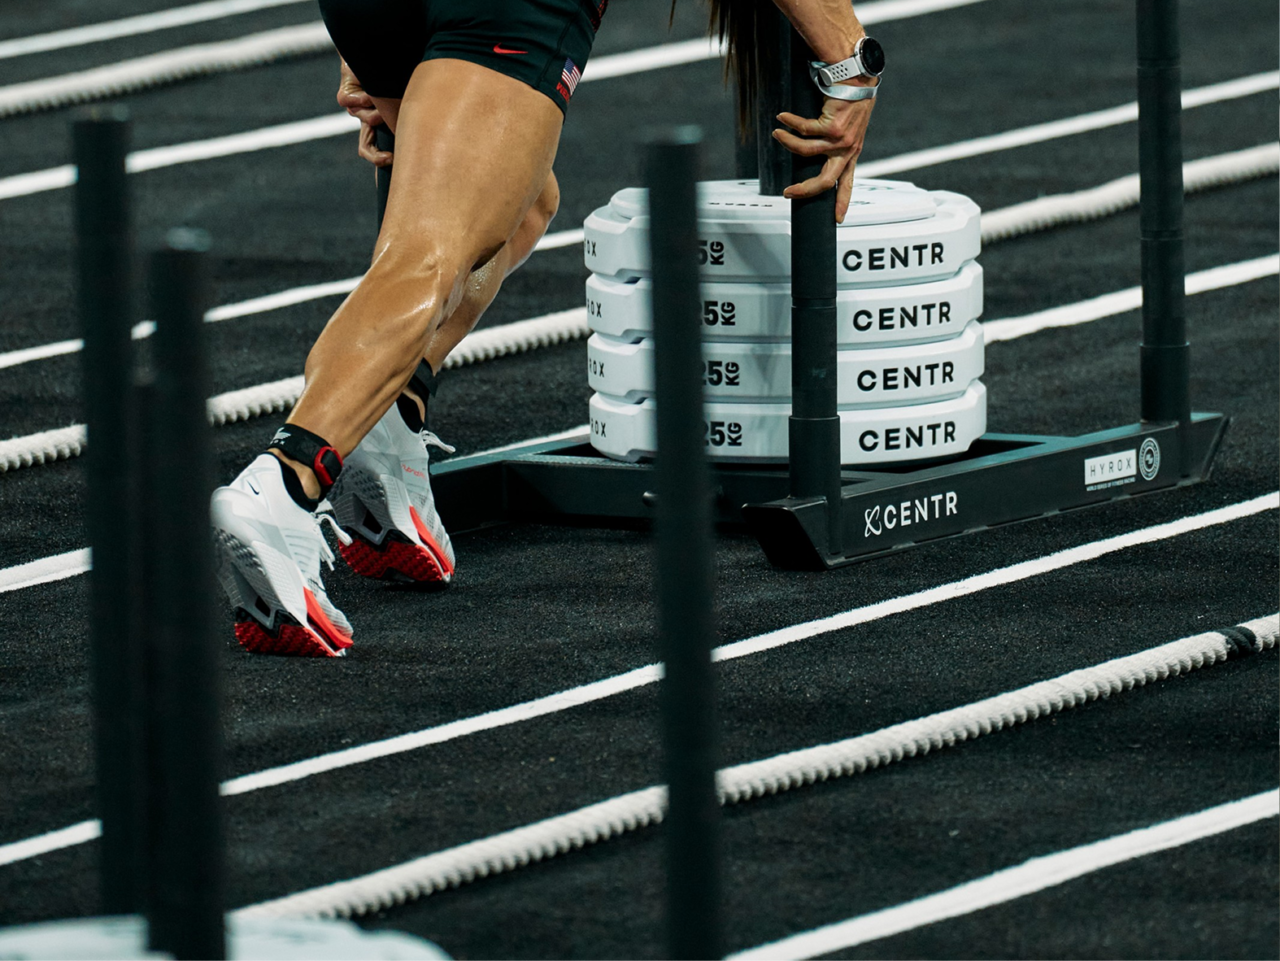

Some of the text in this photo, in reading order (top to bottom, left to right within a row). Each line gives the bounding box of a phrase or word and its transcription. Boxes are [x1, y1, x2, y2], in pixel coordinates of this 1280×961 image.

[710, 241, 725, 266] KG
[842, 242, 944, 271] CENTR
[721, 301, 736, 327] KG
[853, 301, 951, 331] CENTR
[725, 361, 740, 387] KG
[857, 361, 955, 392] CENTR
[727, 422, 742, 448] KG
[858, 421, 956, 452] CENTR
[1089, 457, 1133, 478] HYROX
[883, 491, 959, 530] CENTR
